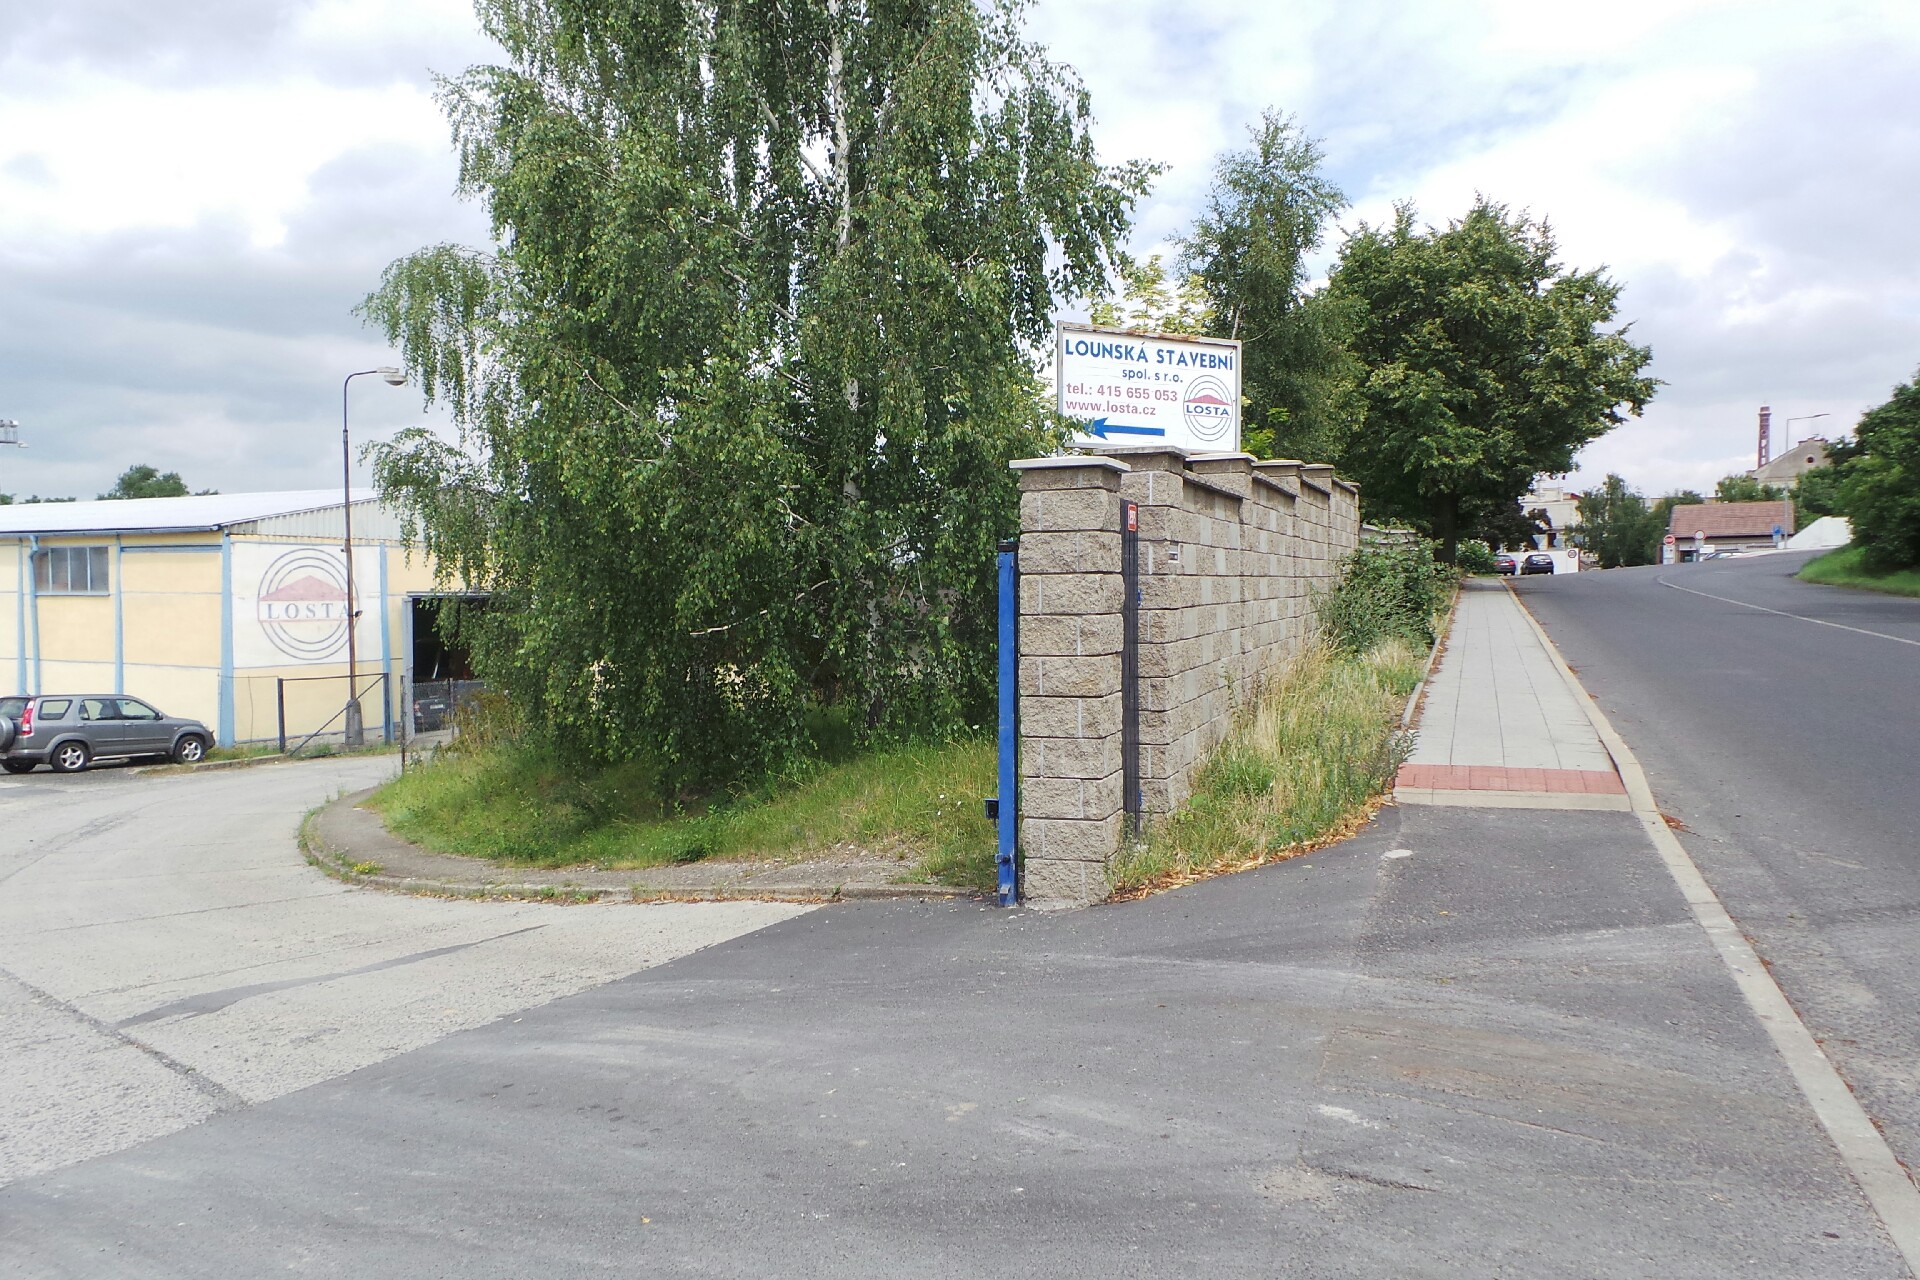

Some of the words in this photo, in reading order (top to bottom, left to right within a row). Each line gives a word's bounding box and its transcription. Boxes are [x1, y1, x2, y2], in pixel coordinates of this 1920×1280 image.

[1066, 339, 1149, 363] LOUNSKÁ
[1156, 349, 1233, 370] STAVEBNÍ
[1122, 368, 1151, 381] spol.
[1154, 372, 1161, 381] s
[1163, 373, 1184, 383] r.o.
[1066, 382, 1093, 395] tel.:
[1097, 384, 1122, 398] 415
[1126, 387, 1150, 400] 655
[1154, 389, 1178, 402] 053
[1066, 400, 1156, 416] www.losta.cz
[1186, 404, 1230, 417] LOSTA
[266, 603, 349, 619] LOSTA
